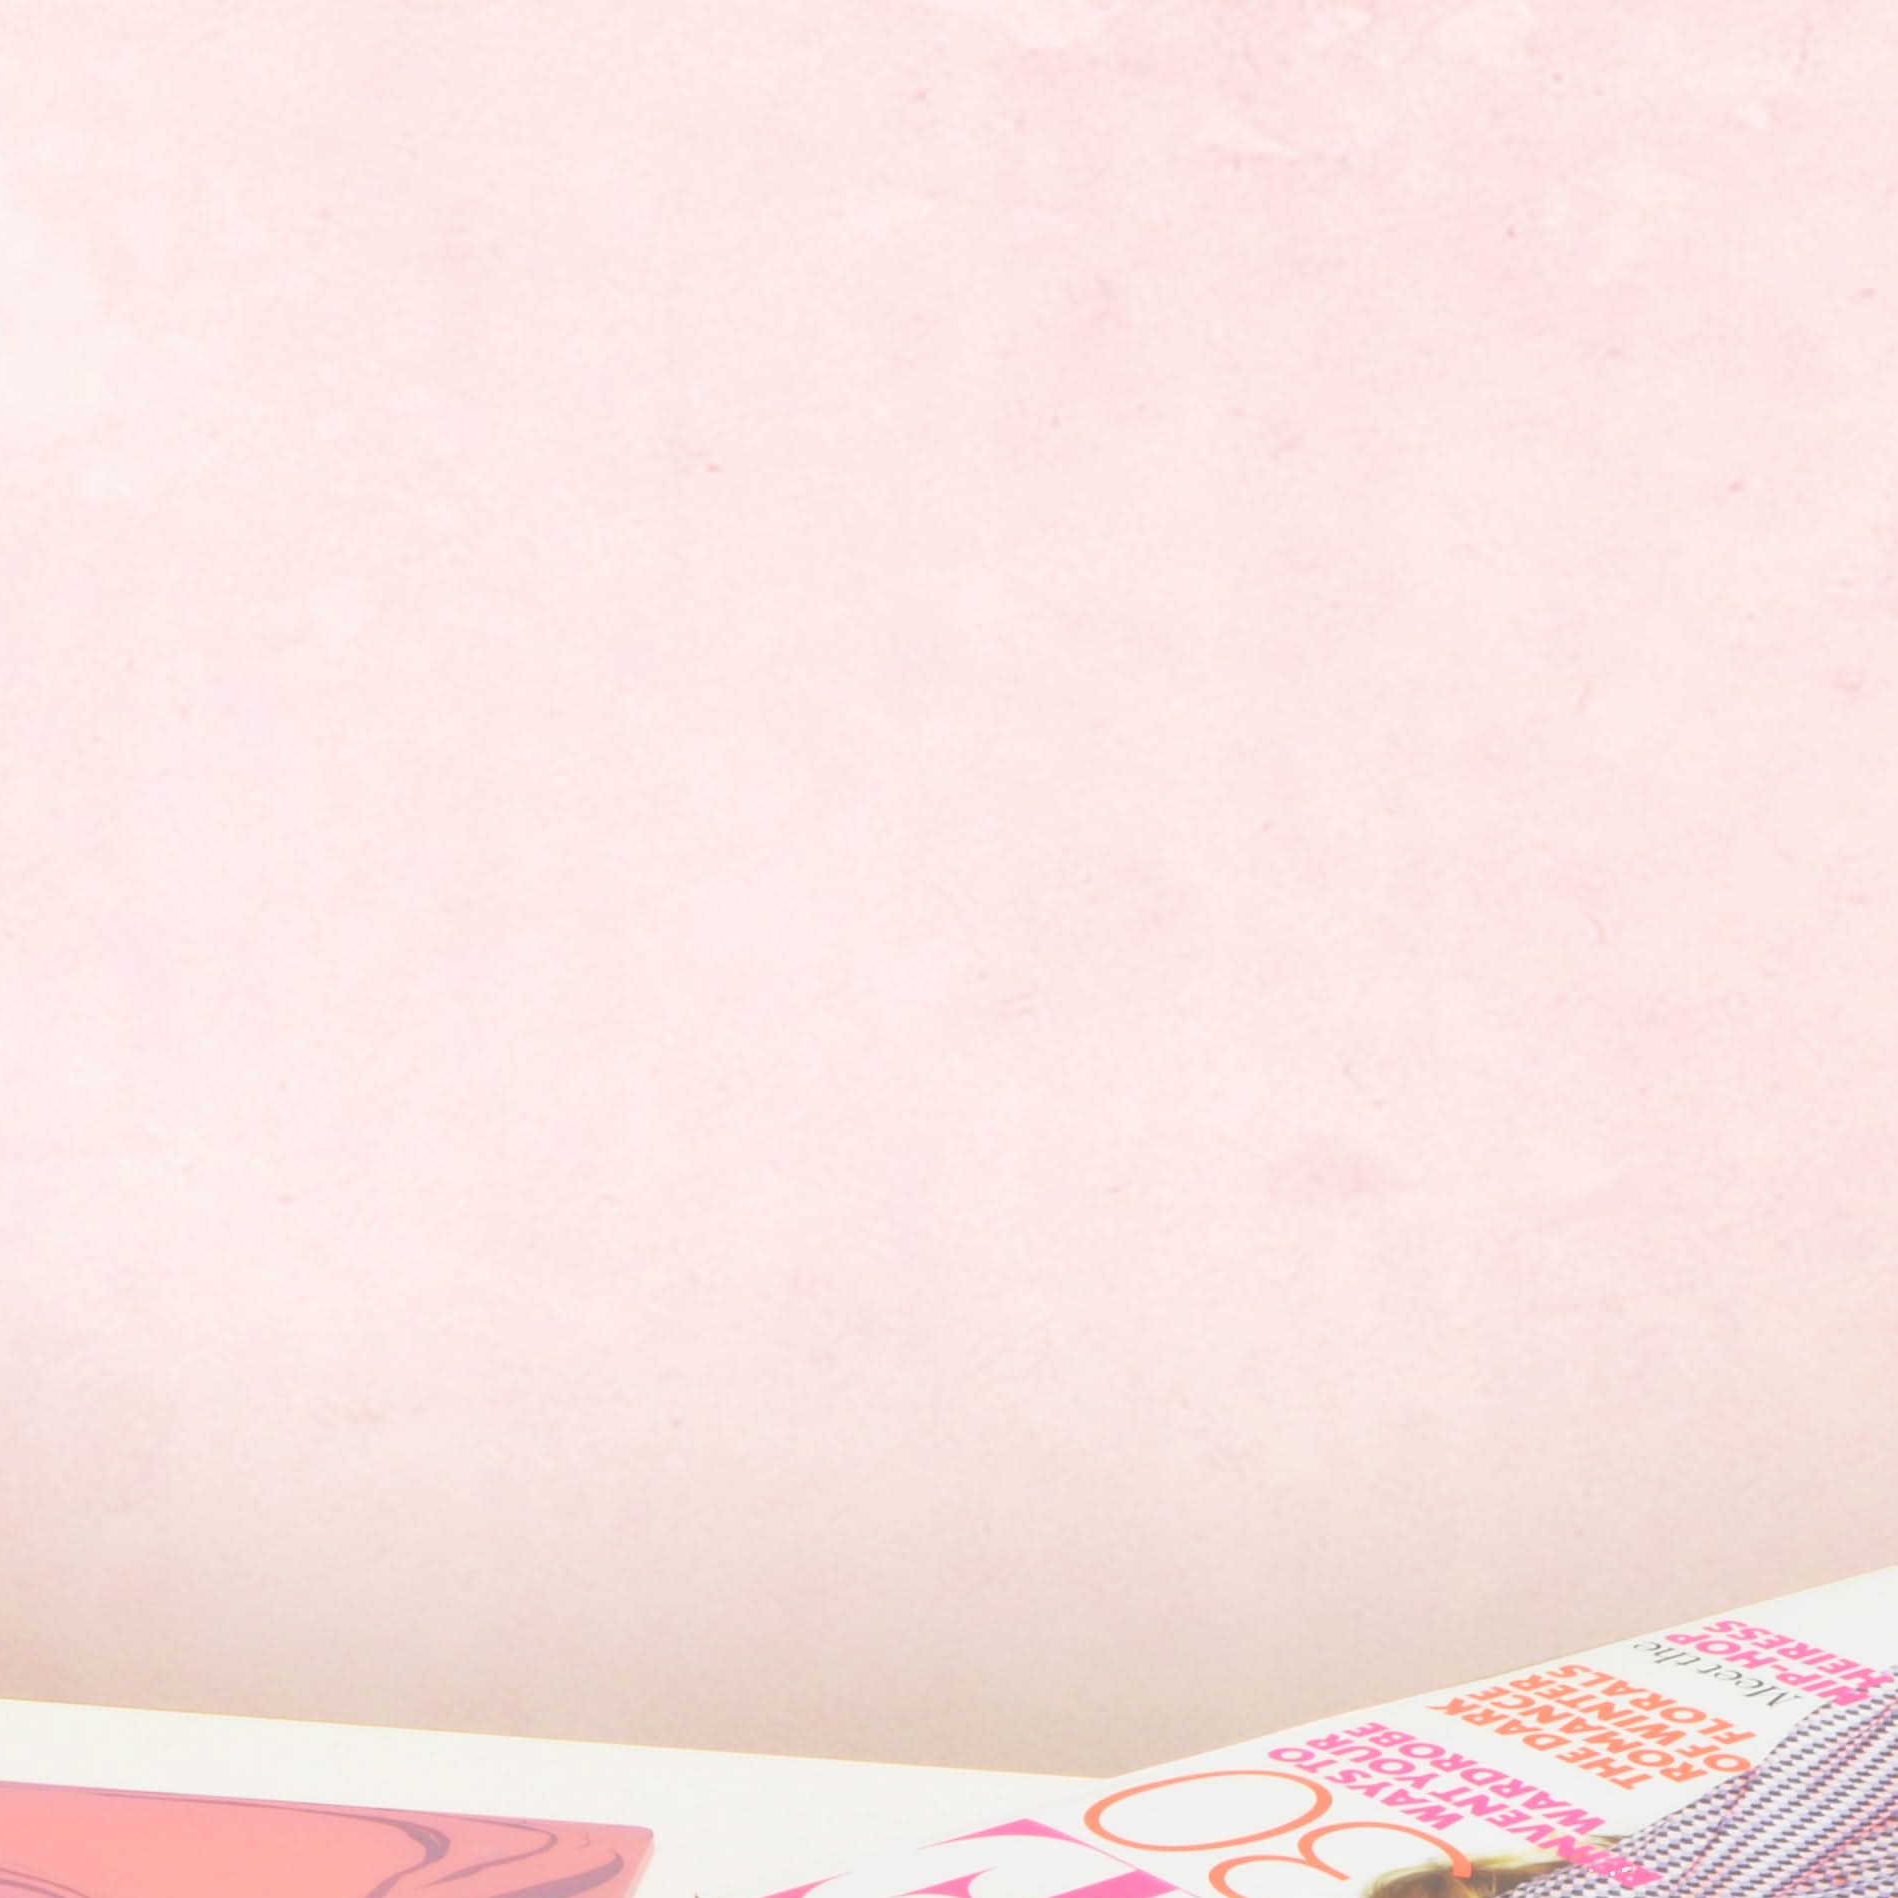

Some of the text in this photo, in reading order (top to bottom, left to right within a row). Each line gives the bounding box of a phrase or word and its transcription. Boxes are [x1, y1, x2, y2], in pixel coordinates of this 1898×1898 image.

[1633, 1641, 1803, 1707] Meet the
[1665, 1634, 1871, 1706] HIP-HOP
[1702, 1620, 1894, 1690] HEIRESS
[1426, 1697, 1652, 1789] THE DARK
[1466, 1687, 1708, 1782] ROMANCE
[1509, 1674, 1751, 1772] OF WINTER
[1547, 1665, 1757, 1744] FLORALS
[1268, 1747, 1466, 1830] WAYS TO
[1306, 1733, 1439, 1788] YOUR
[1345, 1722, 1606, 1835] WARDROBE
